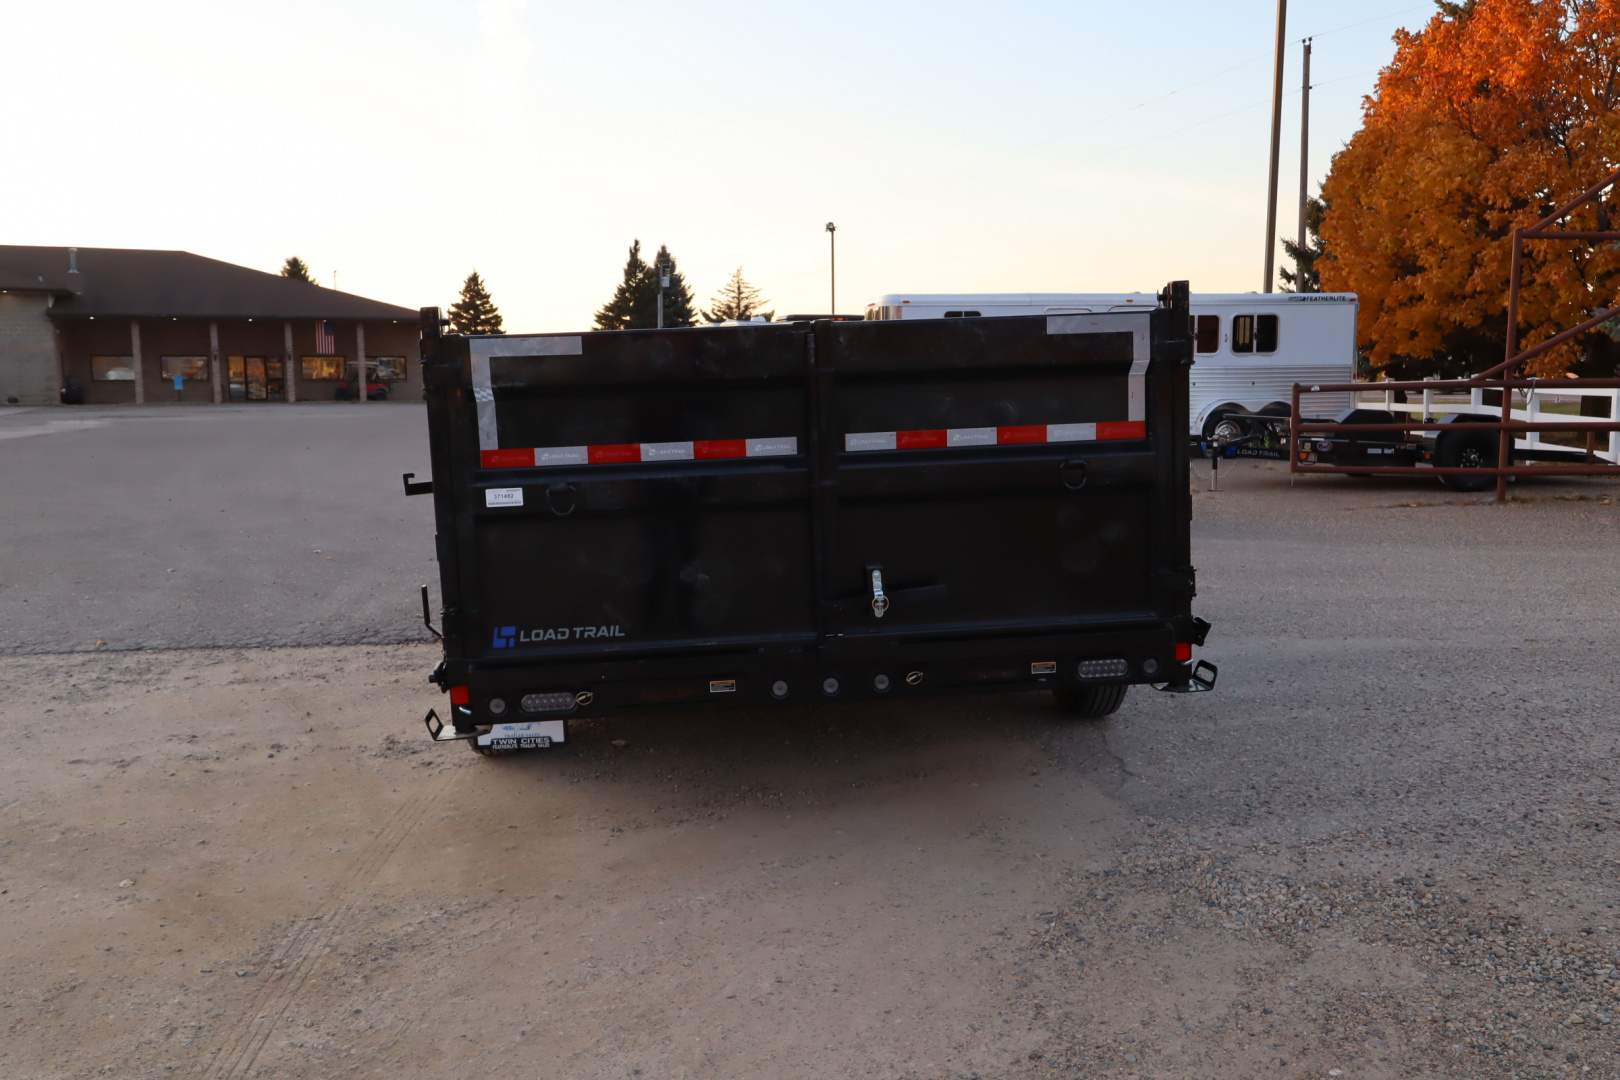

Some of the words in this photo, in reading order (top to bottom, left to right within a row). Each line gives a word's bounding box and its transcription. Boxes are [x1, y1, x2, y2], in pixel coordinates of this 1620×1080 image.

[519, 628, 570, 642] LOAD
[573, 624, 625, 639] TRAIL
[521, 736, 550, 744] CITIES
